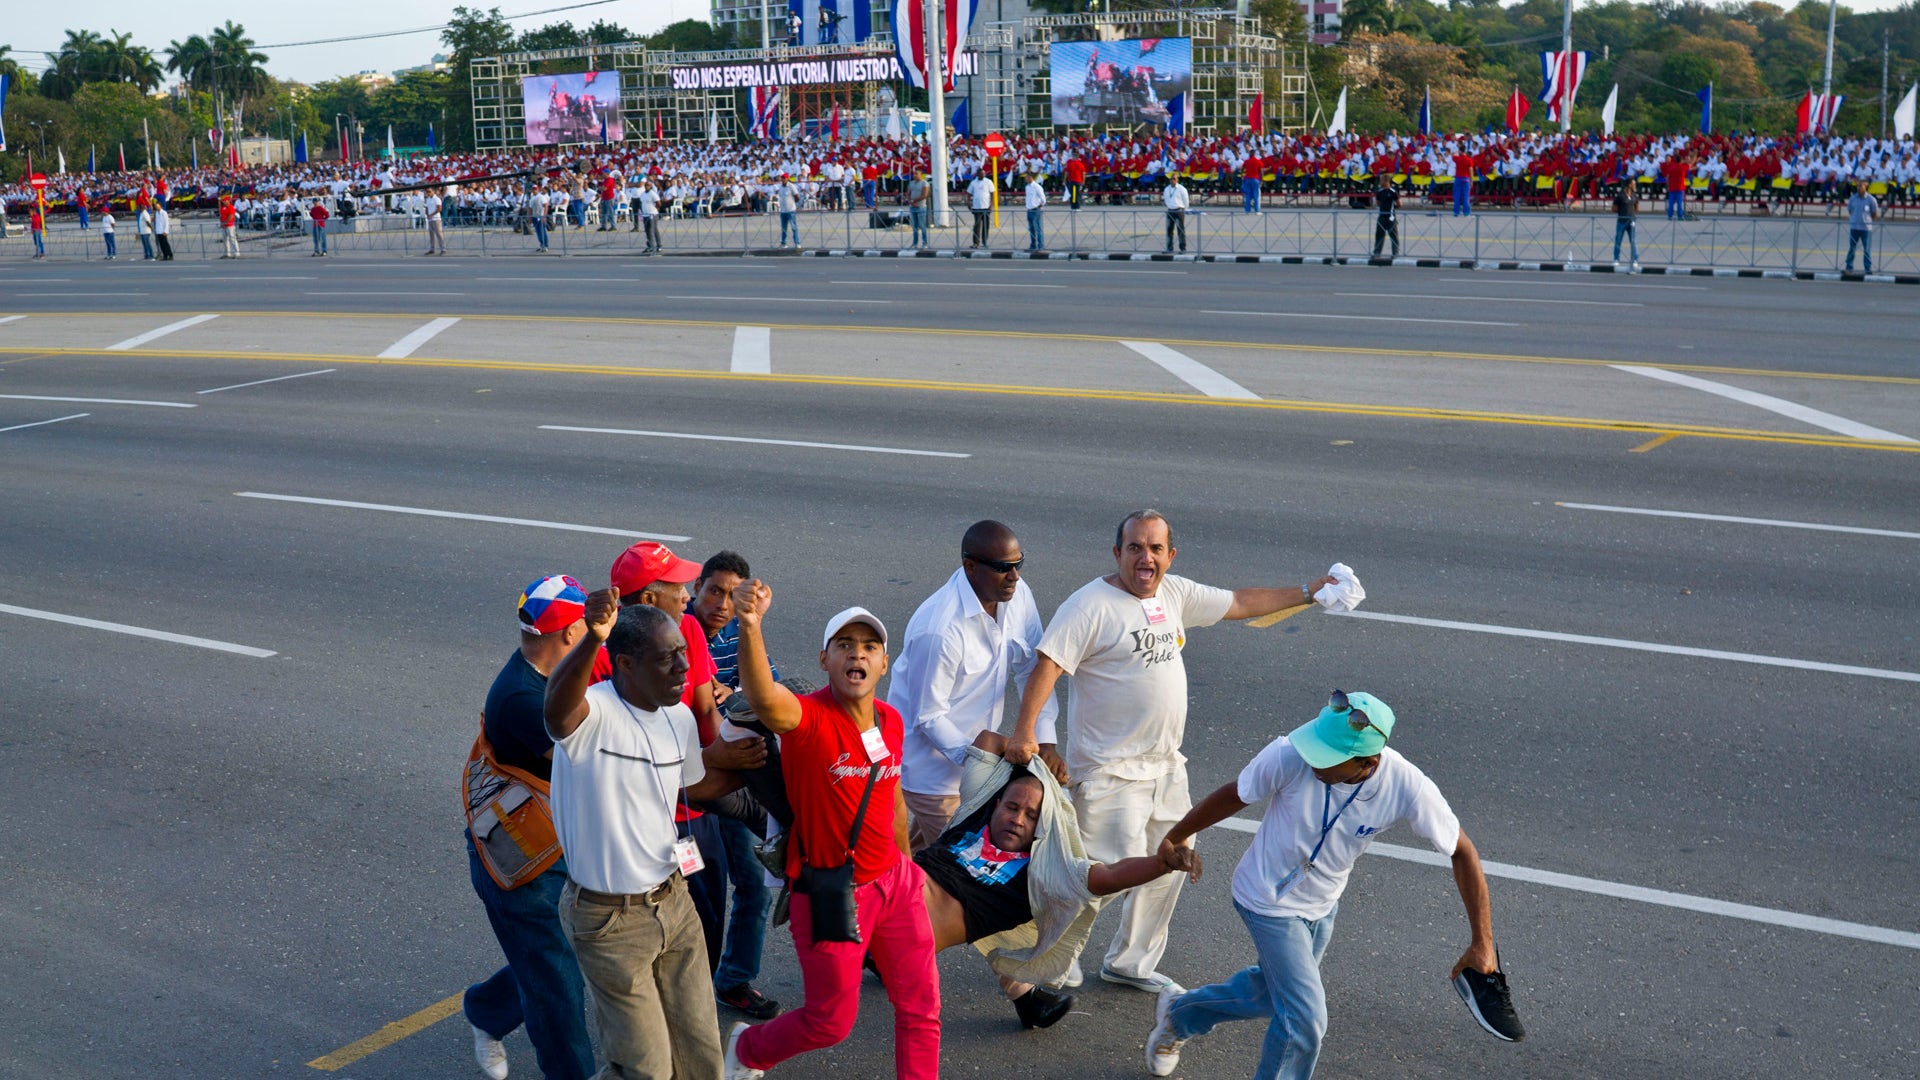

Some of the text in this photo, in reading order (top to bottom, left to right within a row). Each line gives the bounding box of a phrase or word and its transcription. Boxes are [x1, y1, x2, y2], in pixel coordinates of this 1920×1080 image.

[673, 67, 700, 89] SOLO
[701, 66, 723, 89] NOS
[723, 64, 763, 87] ESPERA
[763, 64, 779, 86] LA
[778, 61, 829, 85] VICTORIA
[836, 57, 888, 82] NUESTRO
[1130, 628, 1175, 653] Yo soy
